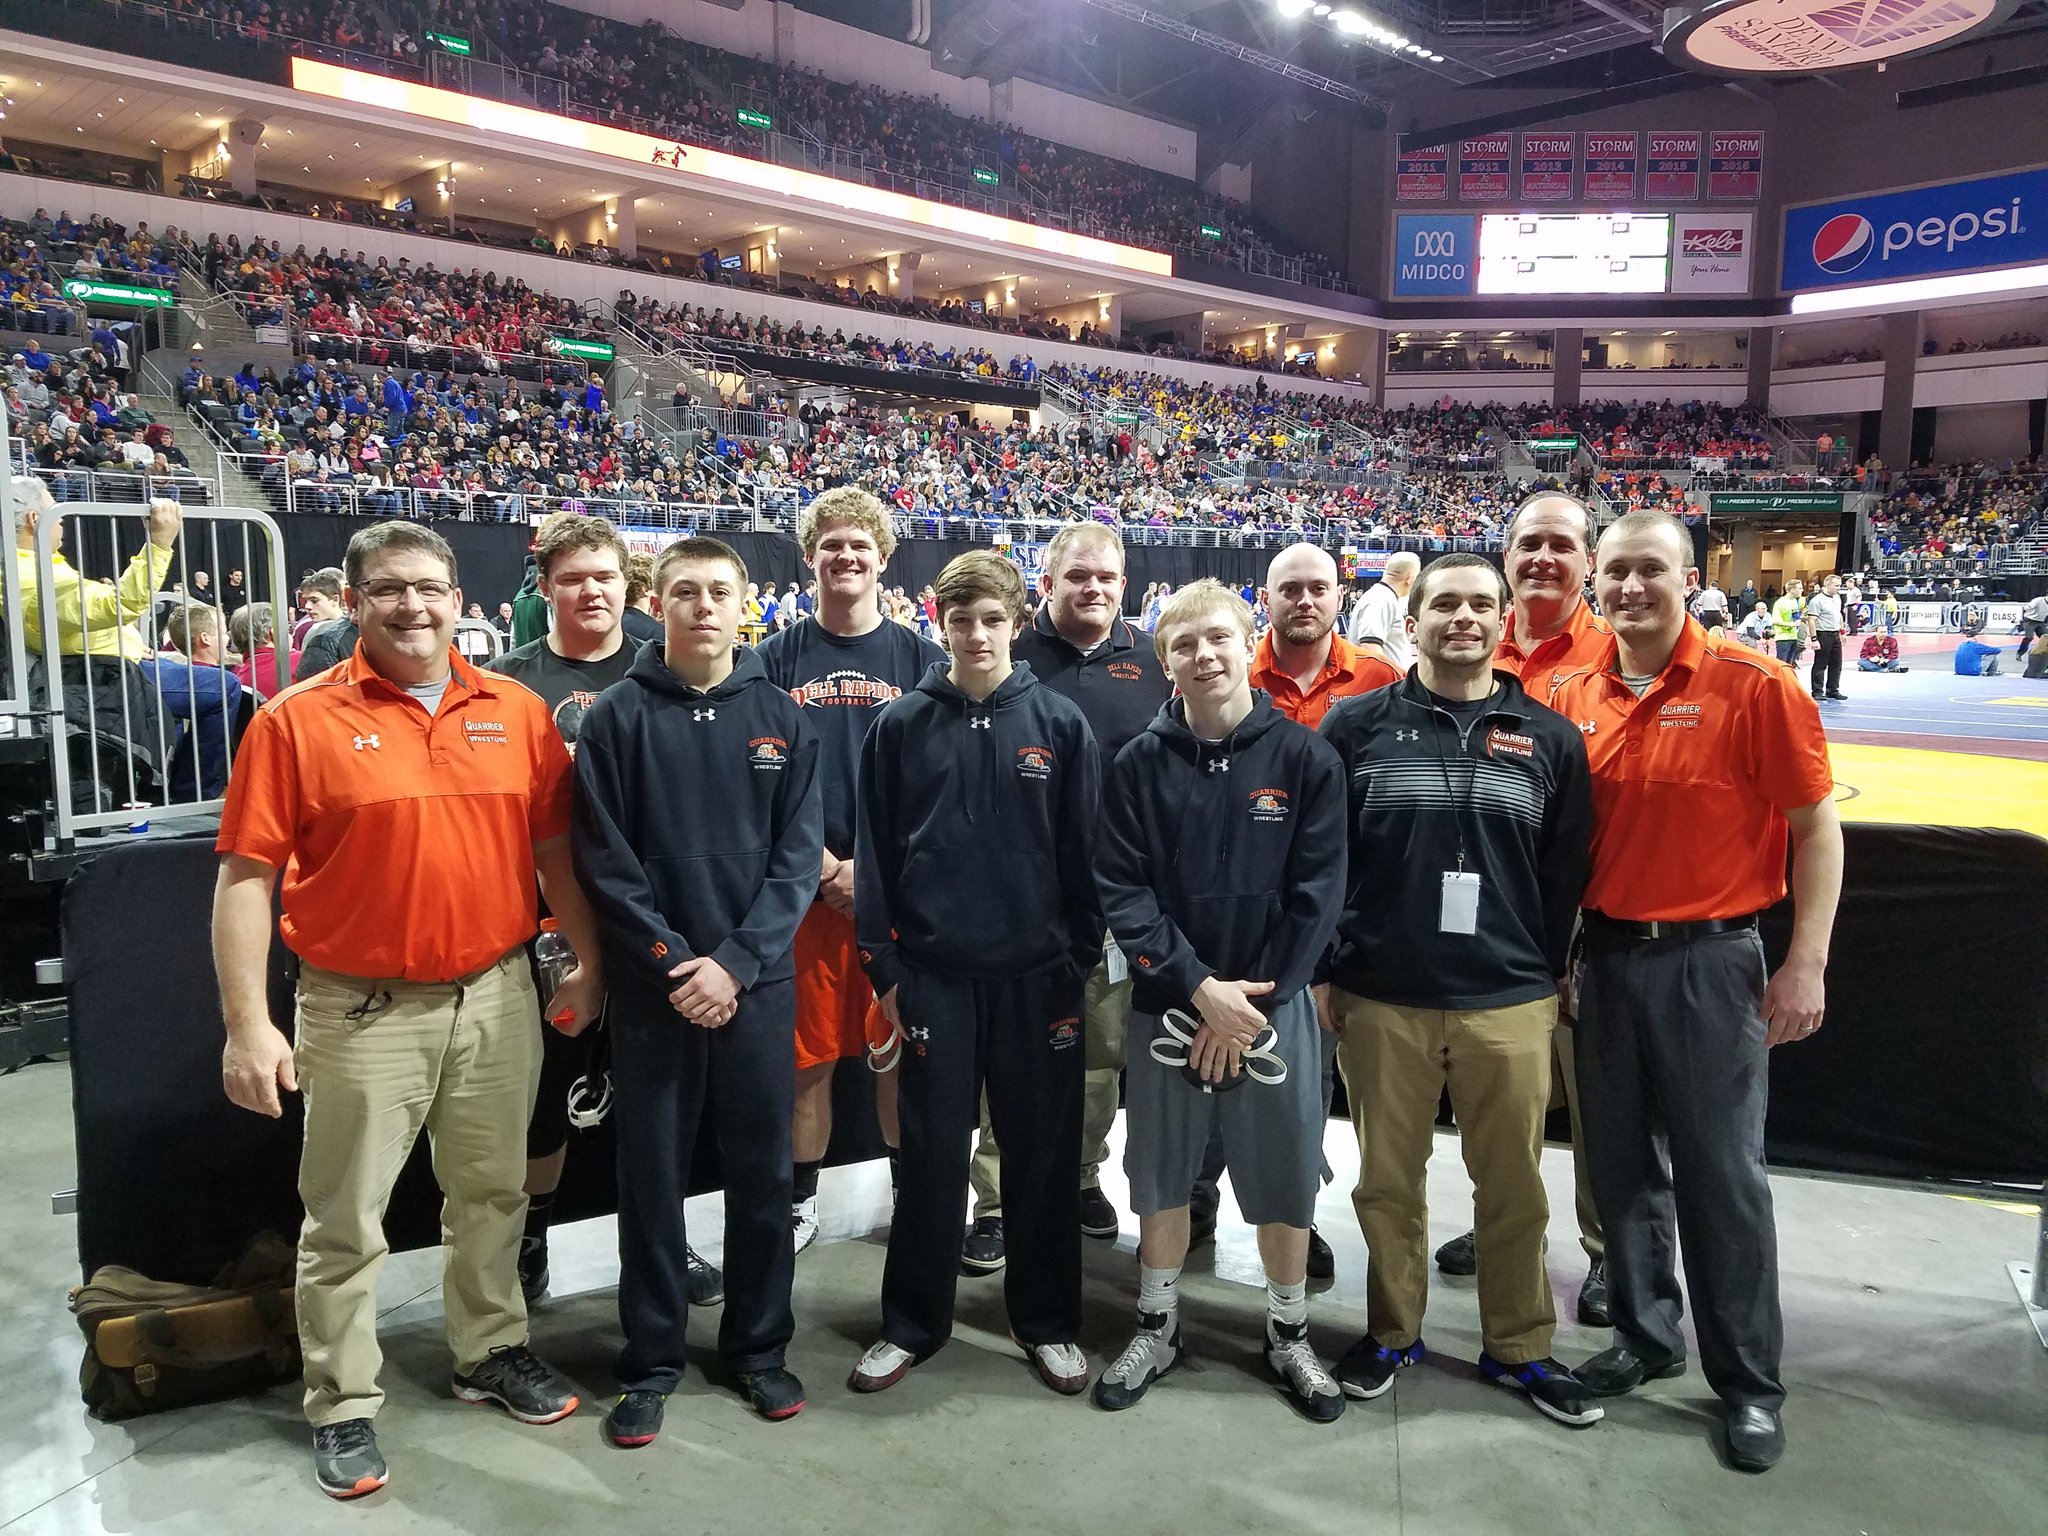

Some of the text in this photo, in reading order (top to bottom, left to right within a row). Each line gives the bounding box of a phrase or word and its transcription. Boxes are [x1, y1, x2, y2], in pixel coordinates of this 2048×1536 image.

[1714, 25, 1769, 52] PREMIER
[1734, 18, 1835, 65] SANFORD
[1772, 17, 1857, 55] DENNY
[1167, 145, 1178, 154] 219
[1464, 141, 1507, 153] STORM
[1526, 141, 1570, 153] STORM
[1589, 140, 1633, 152] STORM
[1652, 140, 1696, 152] STORM
[1714, 140, 1758, 151] STORM
[1408, 163, 1436, 172] 2011
[1471, 162, 1499, 172] 2012
[1533, 162, 1562, 172] 2013
[1596, 161, 1625, 170] 2014
[1659, 161, 1687, 171] 2015
[1721, 161, 1750, 170] 2016
[1882, 197, 2020, 260] pepsi
[1402, 264, 1465, 280] MIDCO
[1691, 264, 1730, 276] Your Home
[1992, 612, 2017, 621] CLASS
[1107, 662, 1142, 675] DELL RAPIDS
[791, 680, 902, 707] DELL RAPIDS
[1661, 704, 1701, 715] QUARRIER
[465, 721, 504, 731] QUARRIER
[469, 735, 508, 743] WRESTLING
[1493, 729, 1533, 746] QUARRIER
[1492, 743, 1533, 757] WRESTLING
[1021, 772, 1047, 780] WRESTLING
[1249, 788, 1289, 800] QUARRIER
[650, 942, 668, 959] 10
[1138, 955, 1151, 968] 5
